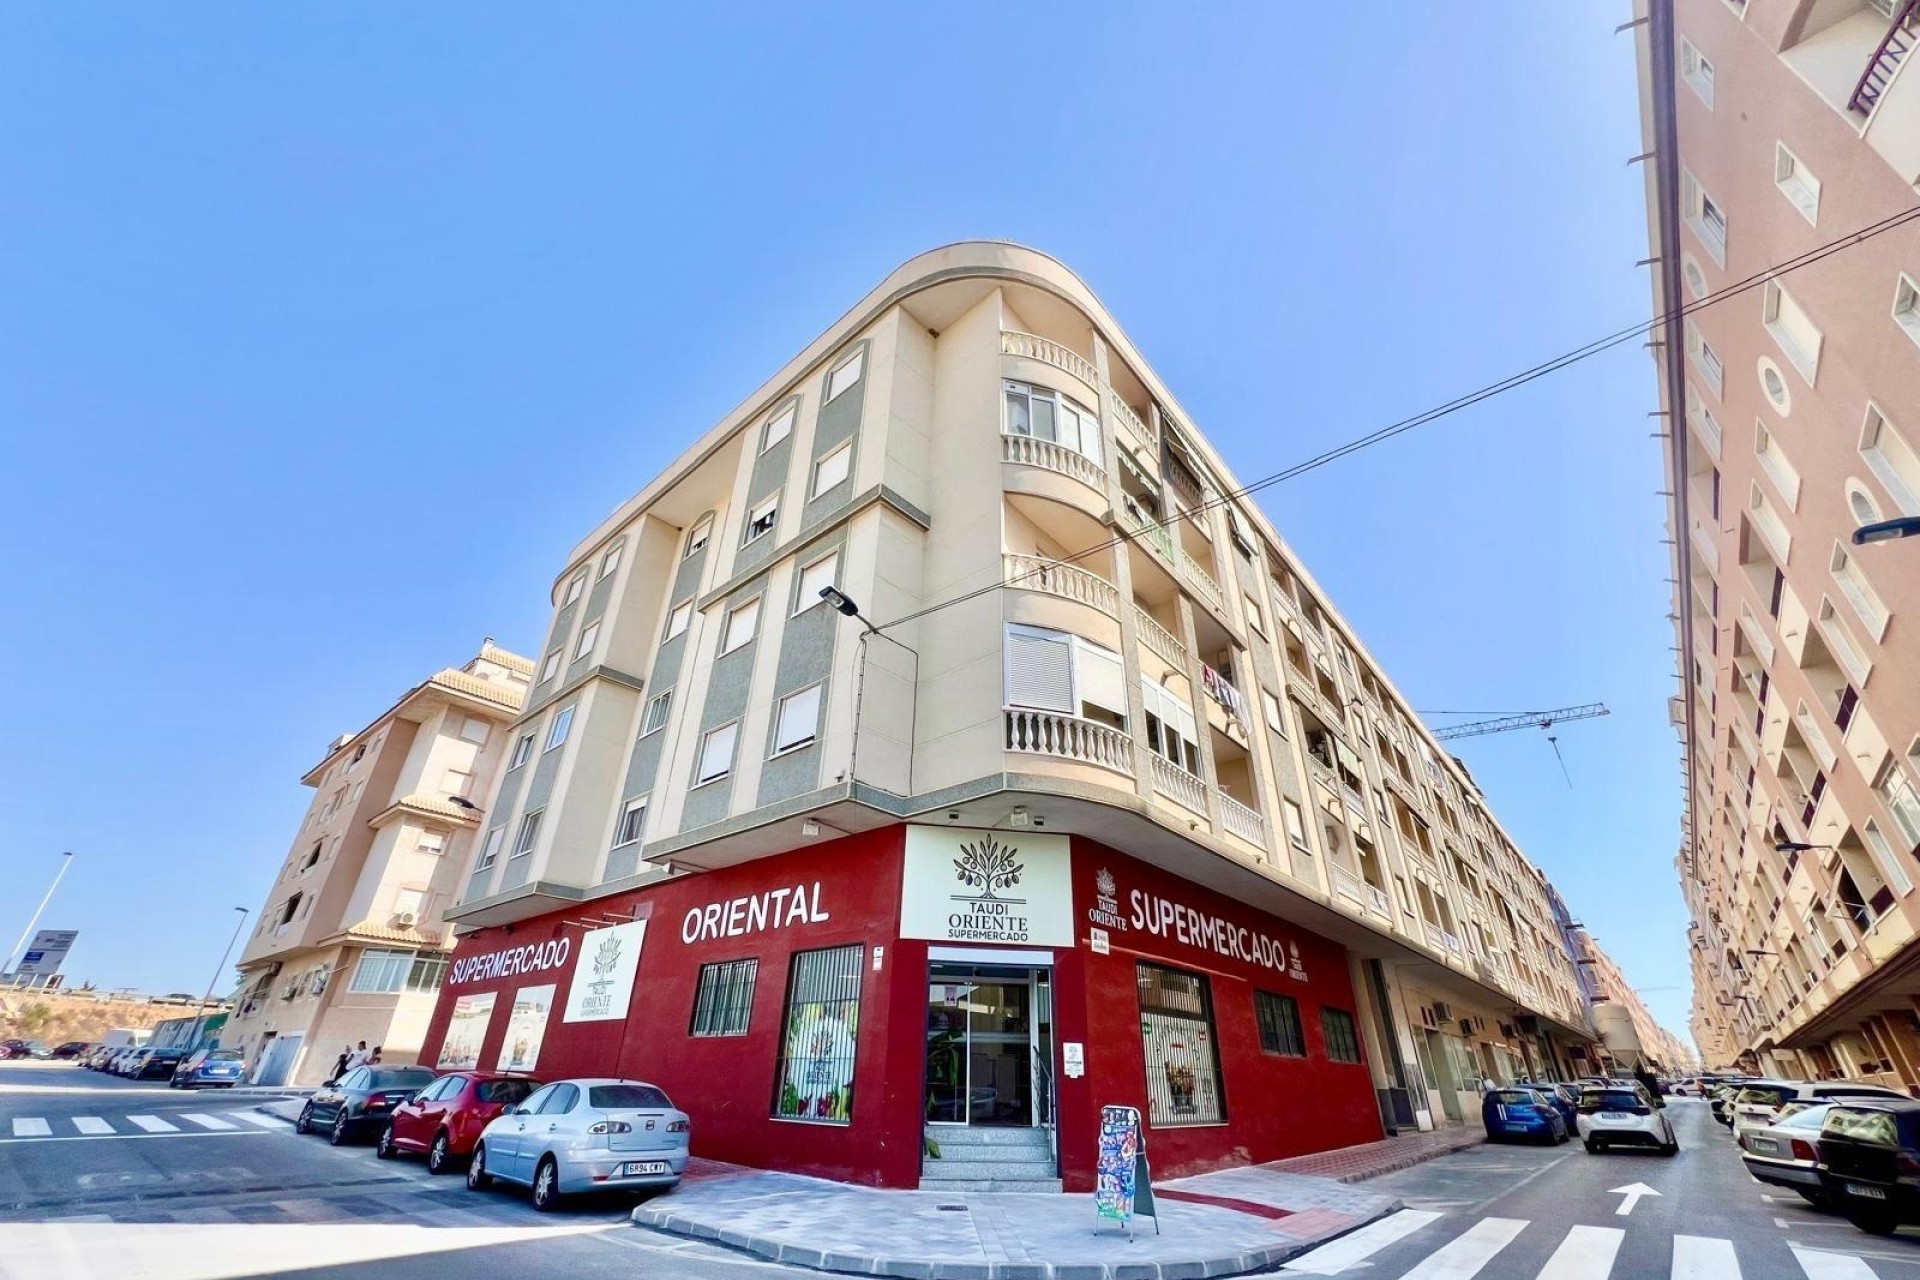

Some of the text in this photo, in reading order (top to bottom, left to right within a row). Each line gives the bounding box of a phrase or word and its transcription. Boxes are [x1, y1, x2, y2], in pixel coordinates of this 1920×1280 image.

[682, 881, 830, 944] ORIENTAL
[969, 902, 1009, 916] TAUDI
[1089, 908, 1128, 931] ORIENTE
[948, 913, 1029, 932] ORIENTE
[1130, 889, 1286, 972] SUPERMERCADO
[948, 928, 1028, 942] SUPERMERCADO
[449, 937, 570, 985] SUPERMERCADO
